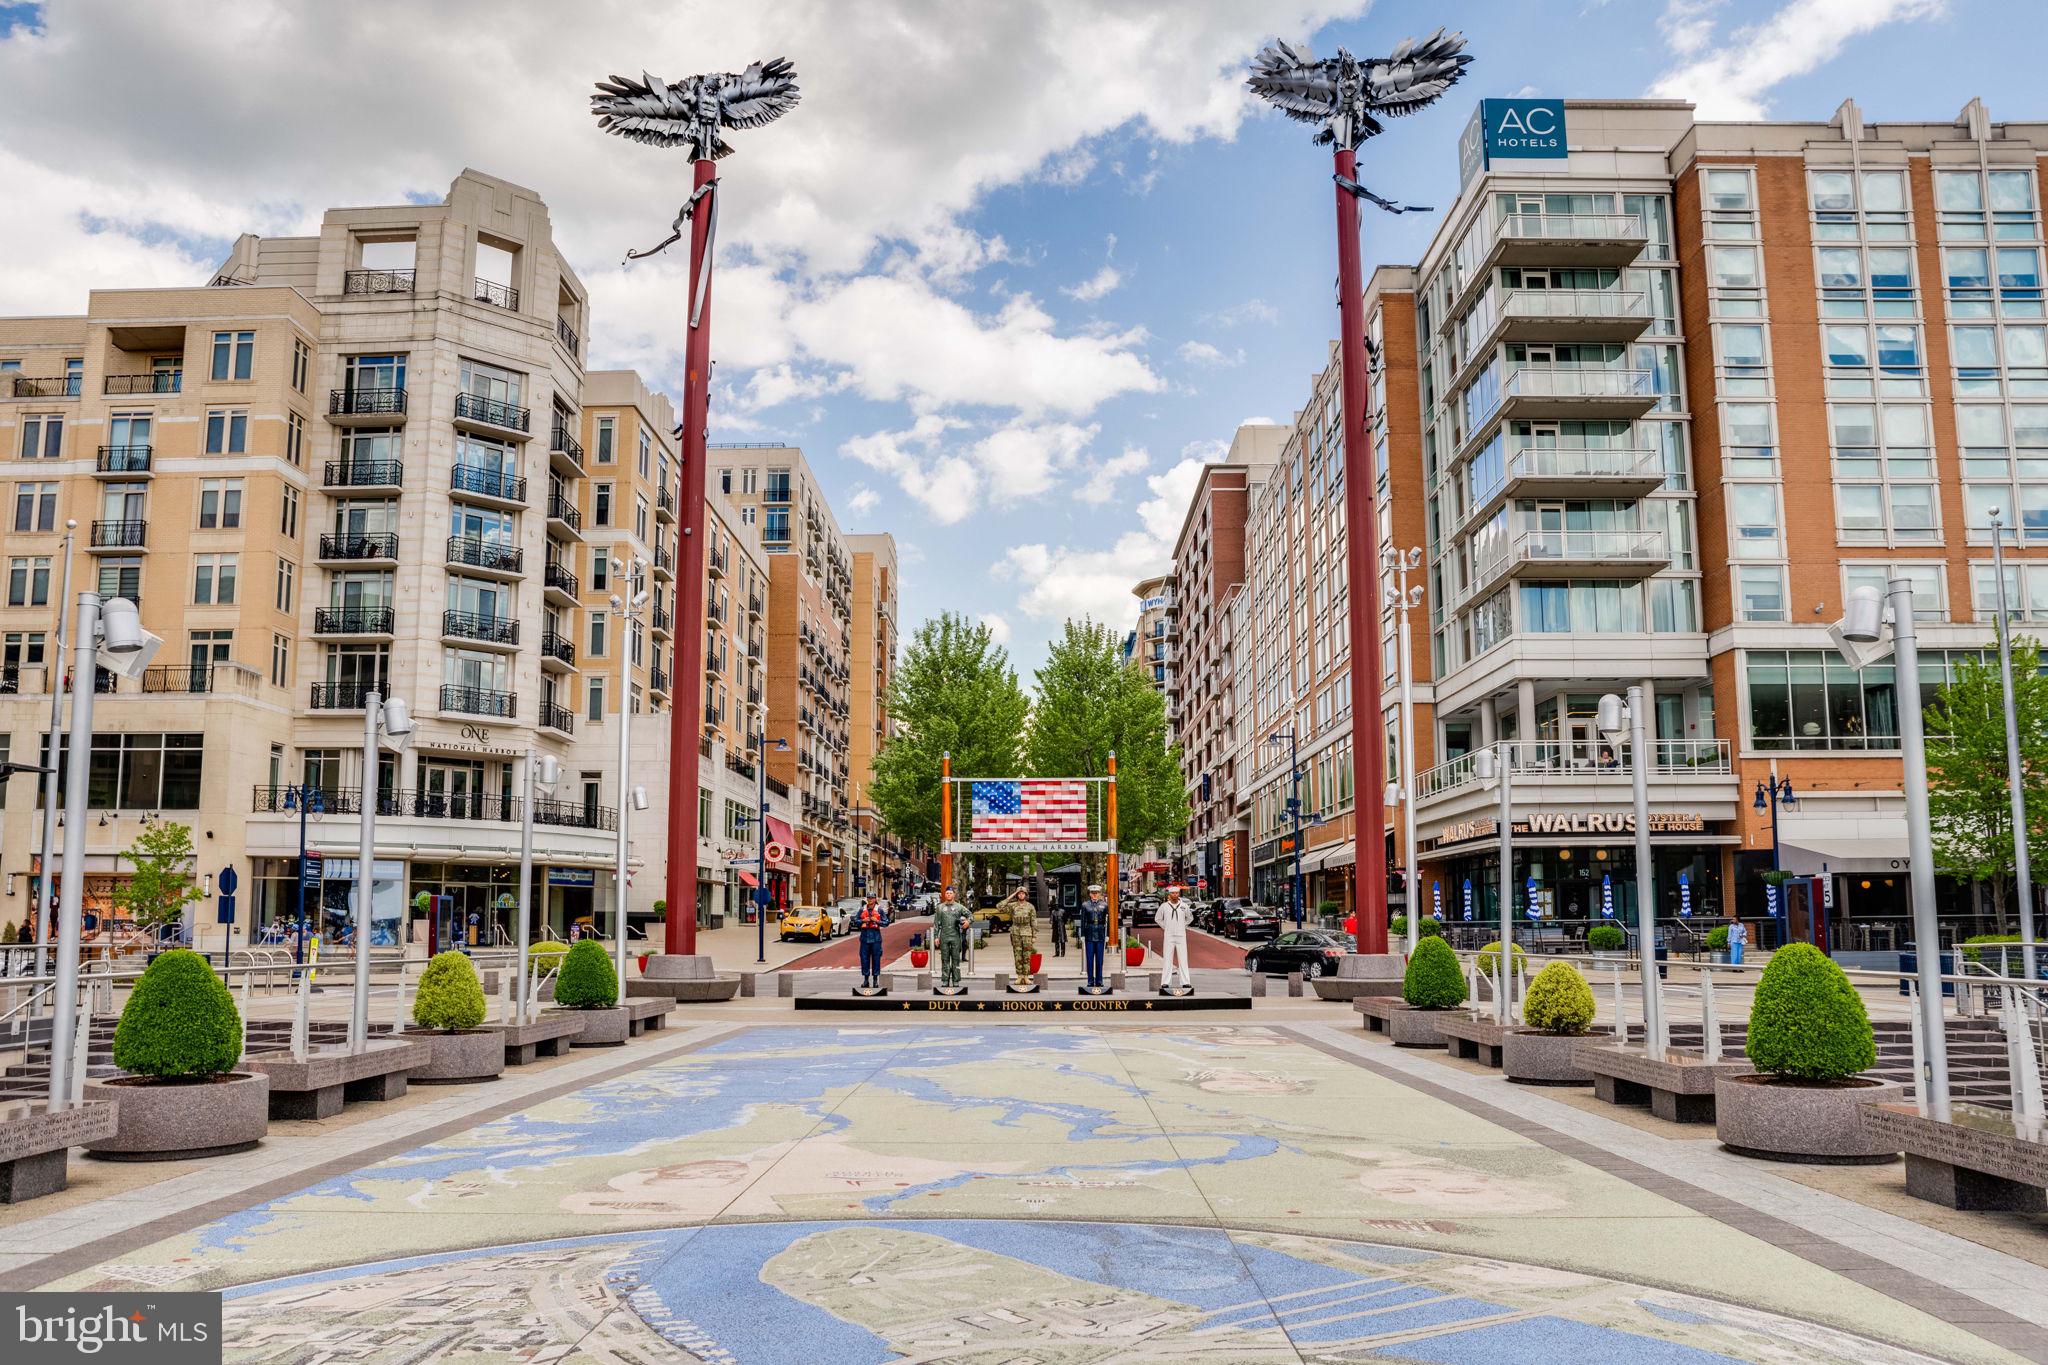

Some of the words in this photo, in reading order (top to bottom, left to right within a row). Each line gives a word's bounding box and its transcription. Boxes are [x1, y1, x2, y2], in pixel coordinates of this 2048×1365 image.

[1497, 107, 1556, 135] AC
[1498, 138, 1558, 147] HOTELS
[461, 723, 490, 743] ONE
[430, 742, 477, 752] NATIONAL
[483, 746, 517, 755] HARBOR
[1528, 813, 1636, 833] WALRUS
[1667, 823, 1704, 832] HOUSE
[1442, 820, 1475, 844] WALRUS
[1224, 842, 1232, 876] BOMBAY
[1579, 868, 1590, 876] 152
[1824, 890, 1831, 903] 5
[928, 1001, 961, 1010] DUTY
[1002, 1001, 1044, 1011] HONOR
[1072, 1000, 1130, 1010] COUNTRY
